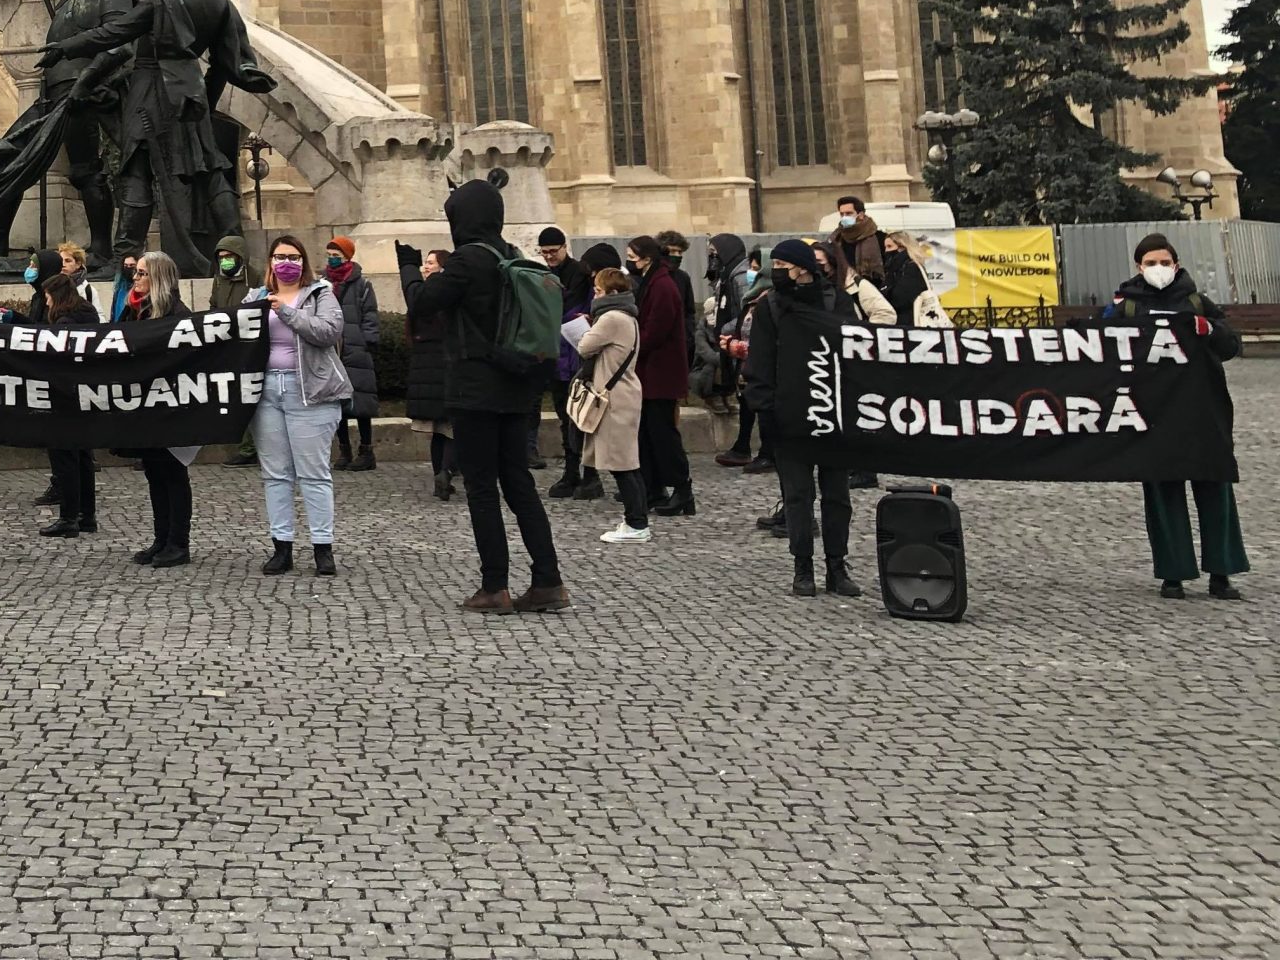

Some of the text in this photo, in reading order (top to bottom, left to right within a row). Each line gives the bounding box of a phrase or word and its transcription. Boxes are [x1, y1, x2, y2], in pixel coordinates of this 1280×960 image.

[978, 253, 1050, 263] WE BUILD ON
[168, 308, 262, 348] ARE
[78, 371, 264, 414] NUANȚE
